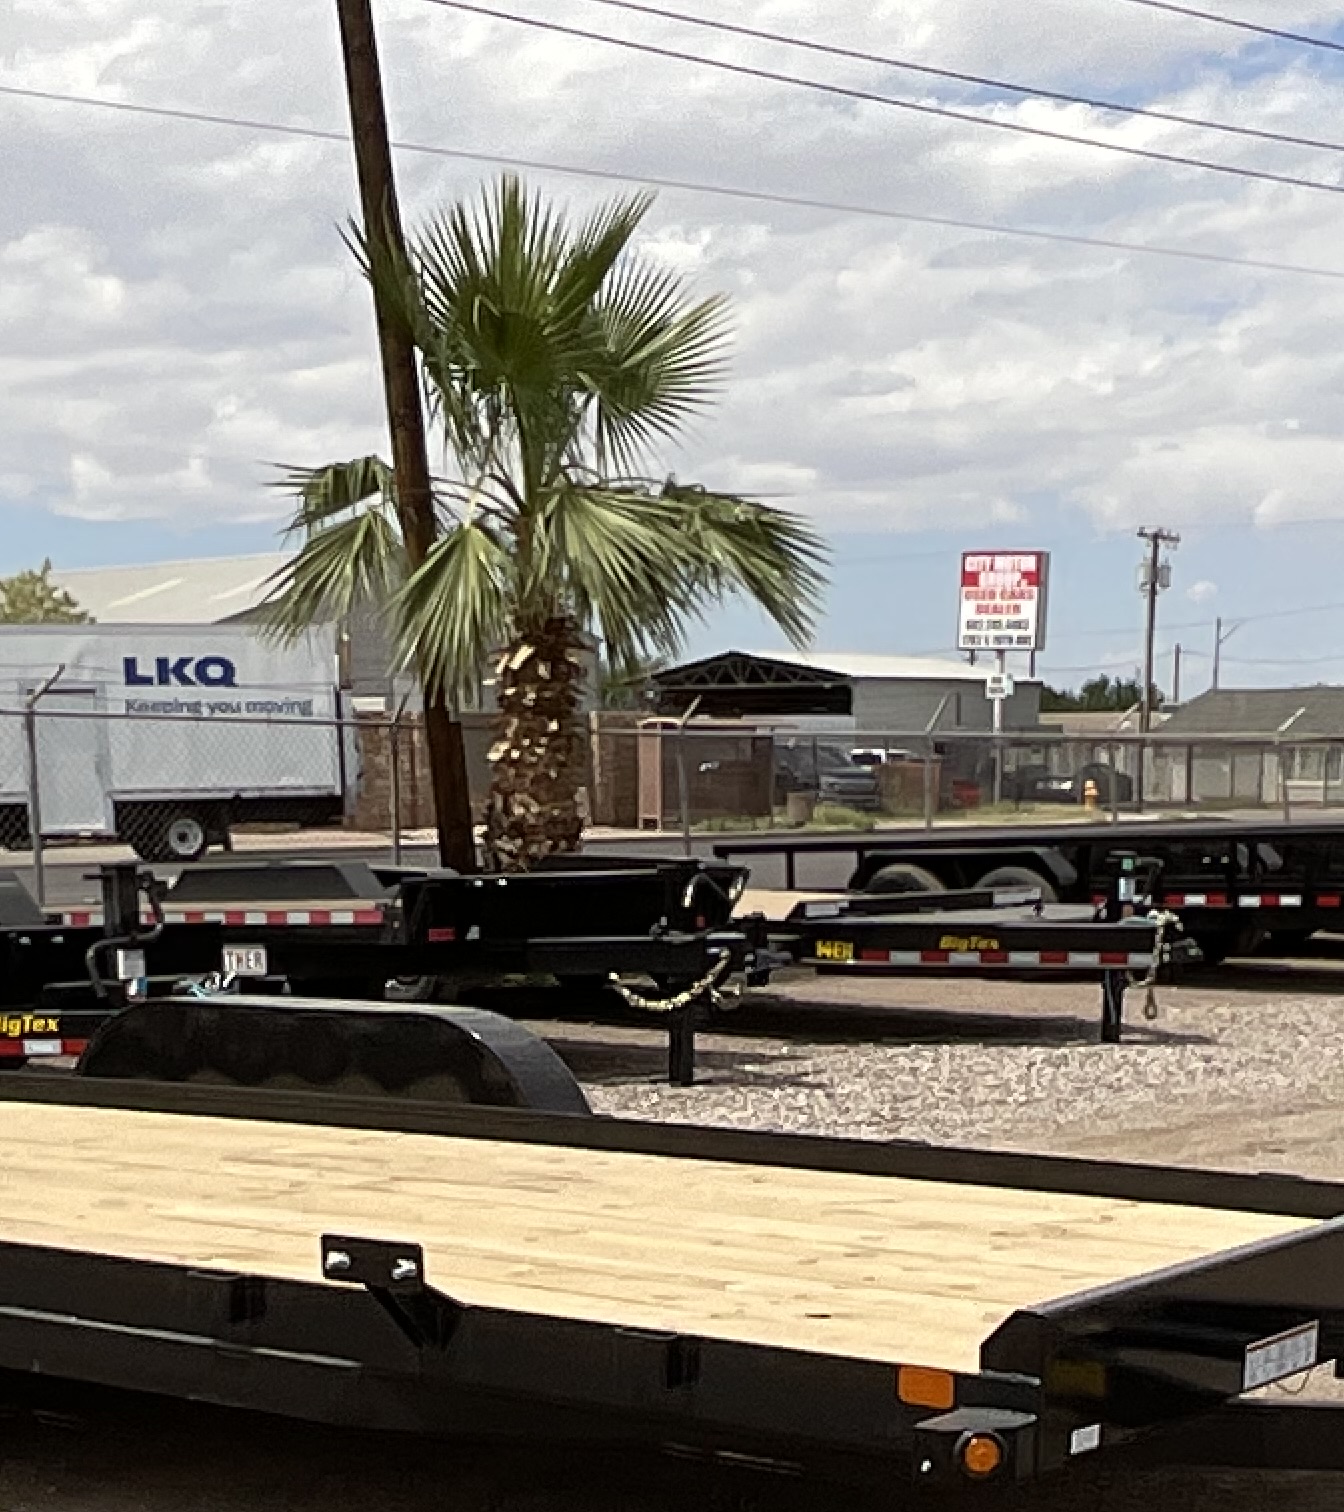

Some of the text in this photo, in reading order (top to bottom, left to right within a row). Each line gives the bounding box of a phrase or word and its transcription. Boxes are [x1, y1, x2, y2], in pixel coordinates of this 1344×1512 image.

[123, 656, 238, 687] LKQ
[125, 697, 313, 716] Keeping you moving
